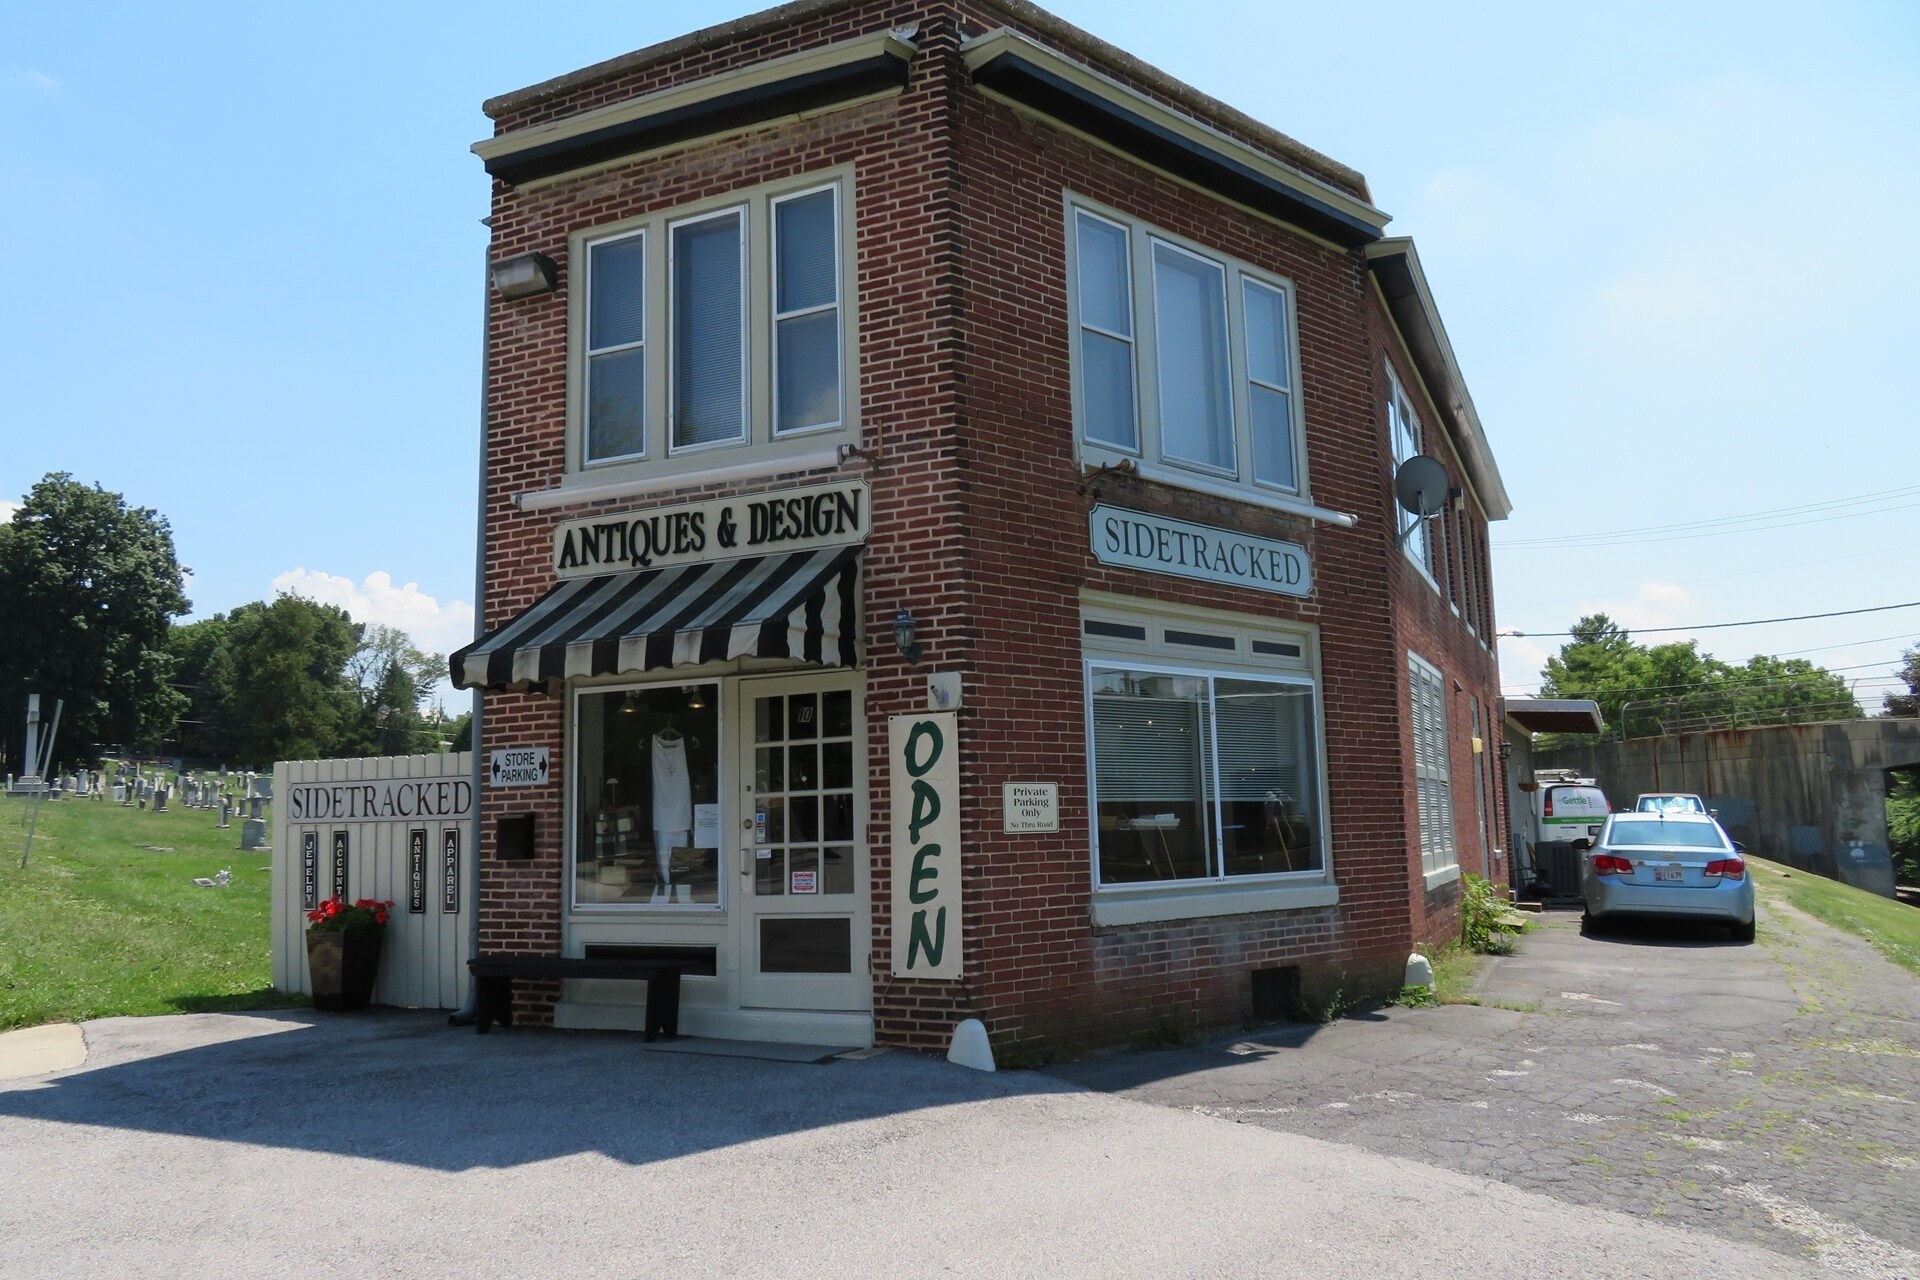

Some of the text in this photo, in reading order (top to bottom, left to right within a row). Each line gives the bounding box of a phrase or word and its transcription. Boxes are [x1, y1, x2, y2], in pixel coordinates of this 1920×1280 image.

[557, 488, 863, 568] ANTIQUES & DESIGN
[1105, 516, 1301, 586] SIDETRACKED
[797, 706, 814, 723] 10
[505, 752, 535, 767] STORE
[501, 767, 538, 782] PARKING
[291, 780, 472, 820] SIDETRACKED
[1013, 787, 1049, 796] Private
[1013, 797, 1050, 808] Parking
[1562, 796, 1588, 805] Gettle
[1021, 808, 1042, 819] Only
[1037, 820, 1054, 828] Road
[903, 720, 947, 970] OPEN
[305, 841, 314, 902] JEWELRY
[412, 836, 422, 908] ANTIQUES
[446, 838, 455, 904] APPAREL
